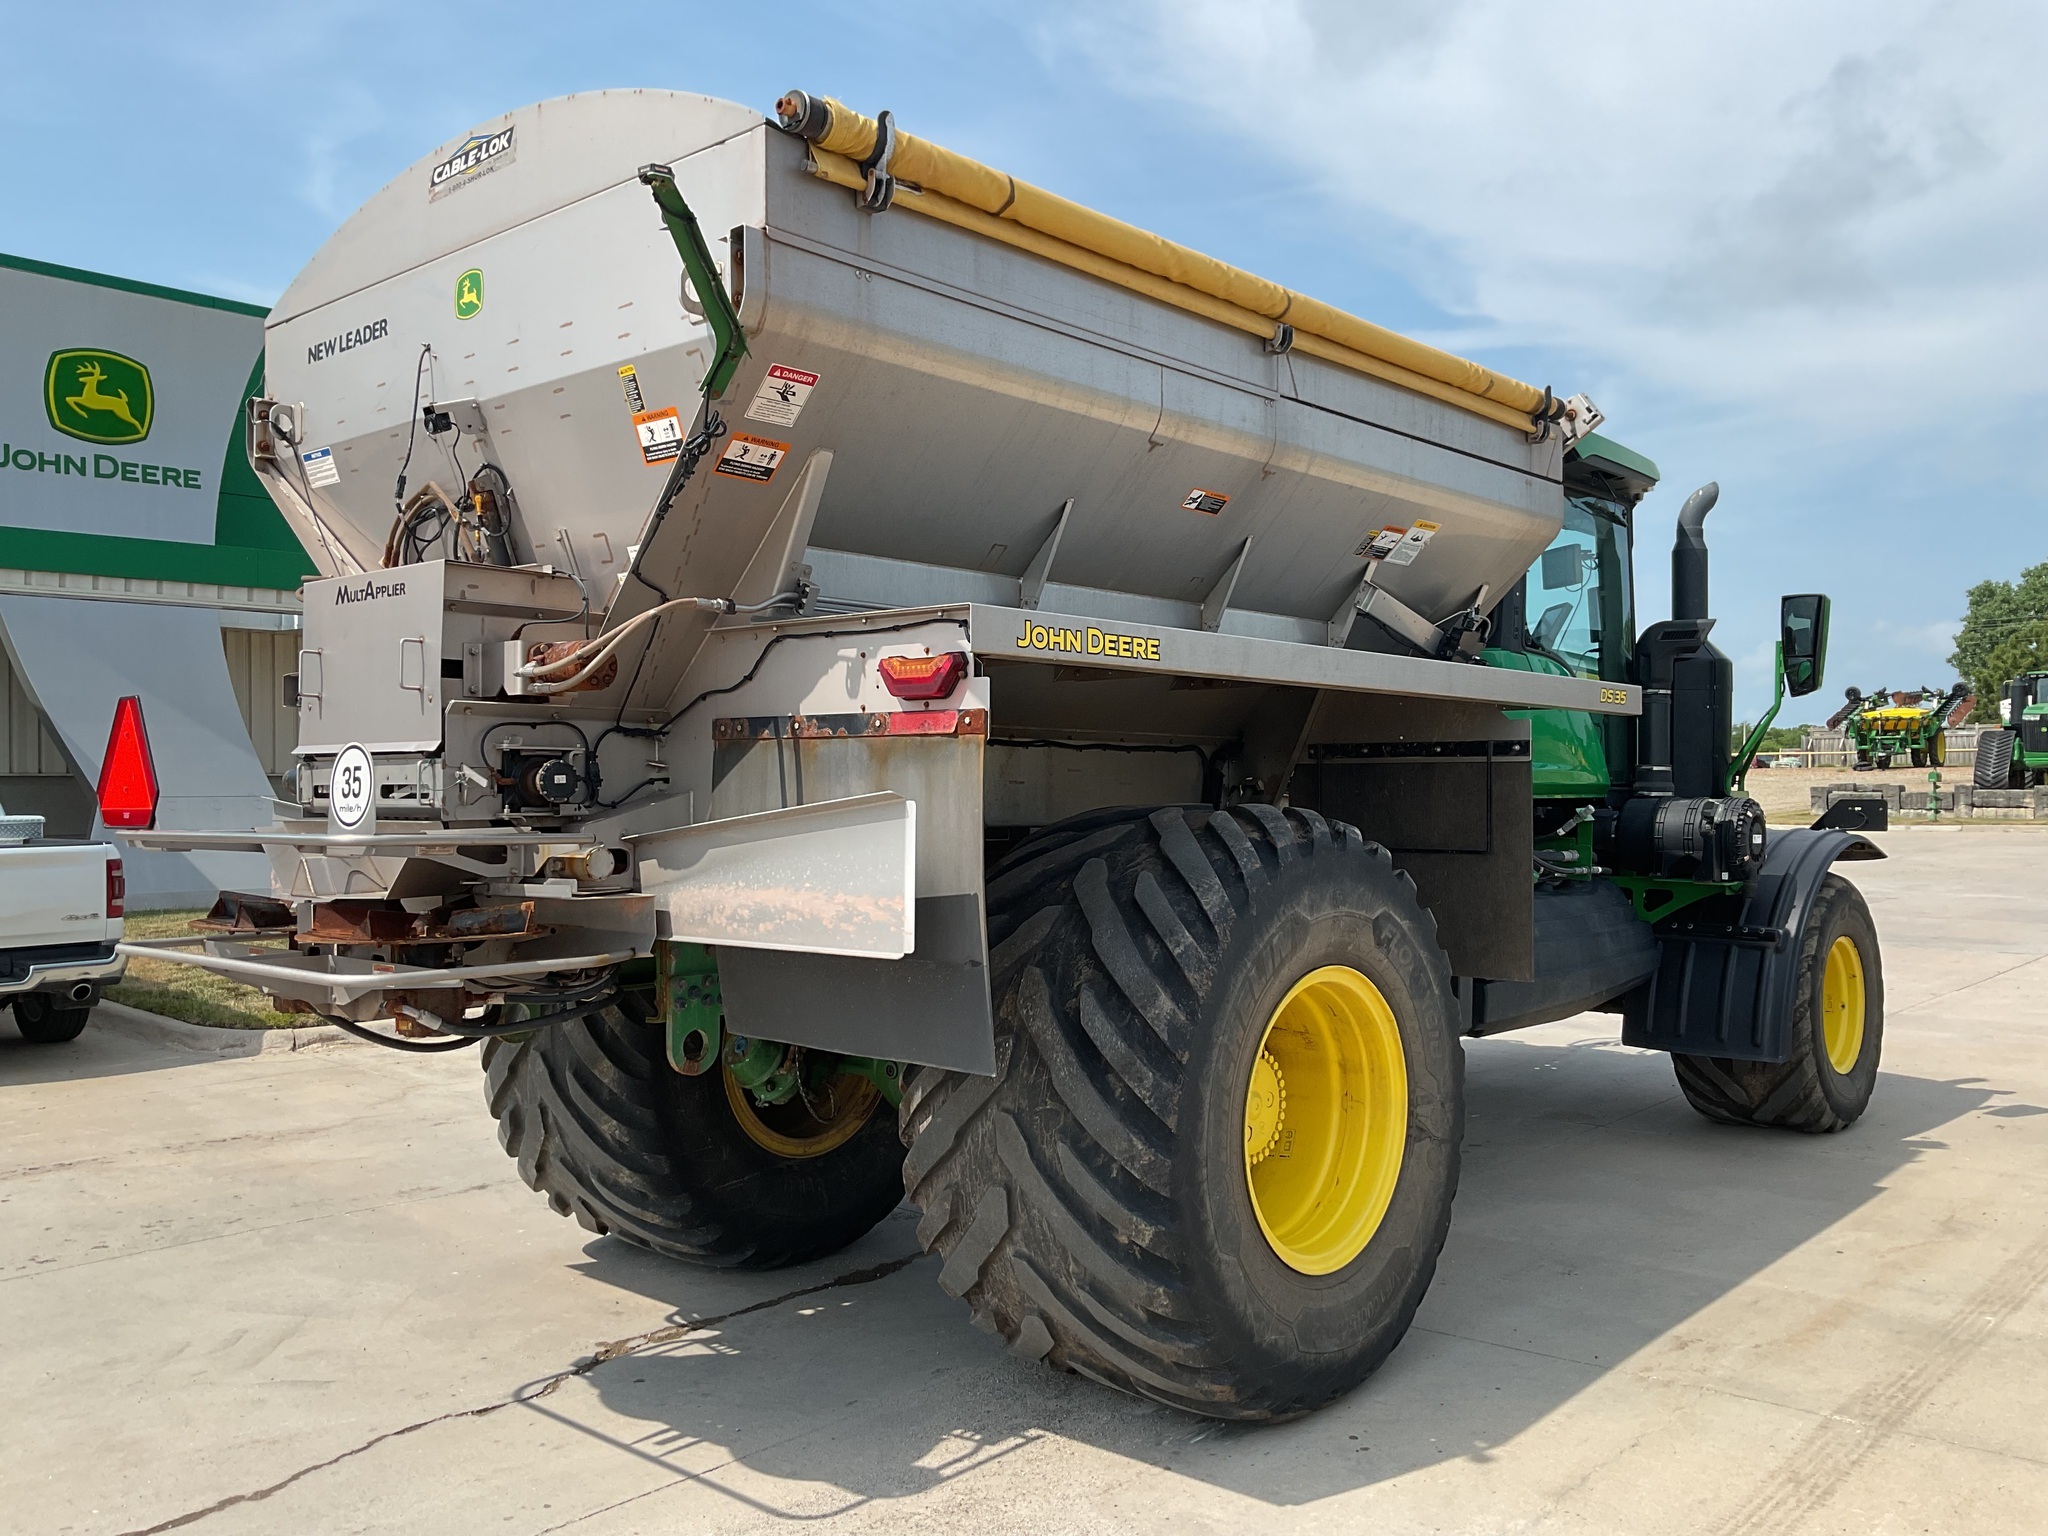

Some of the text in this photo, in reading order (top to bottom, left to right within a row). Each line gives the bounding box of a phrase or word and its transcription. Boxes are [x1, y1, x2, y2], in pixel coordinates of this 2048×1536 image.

[433, 131, 511, 184] CABLE-LOK
[308, 318, 388, 364] NEW LEADER
[782, 371, 814, 383] DANGER
[646, 410, 669, 421] WARNING
[751, 437, 780, 448] WARNING
[0, 443, 201, 489] JOHN DEERE
[1017, 620, 1160, 661] JOHN DEERE
[342, 766, 361, 798] 35
[340, 804, 361, 812] mile/h
